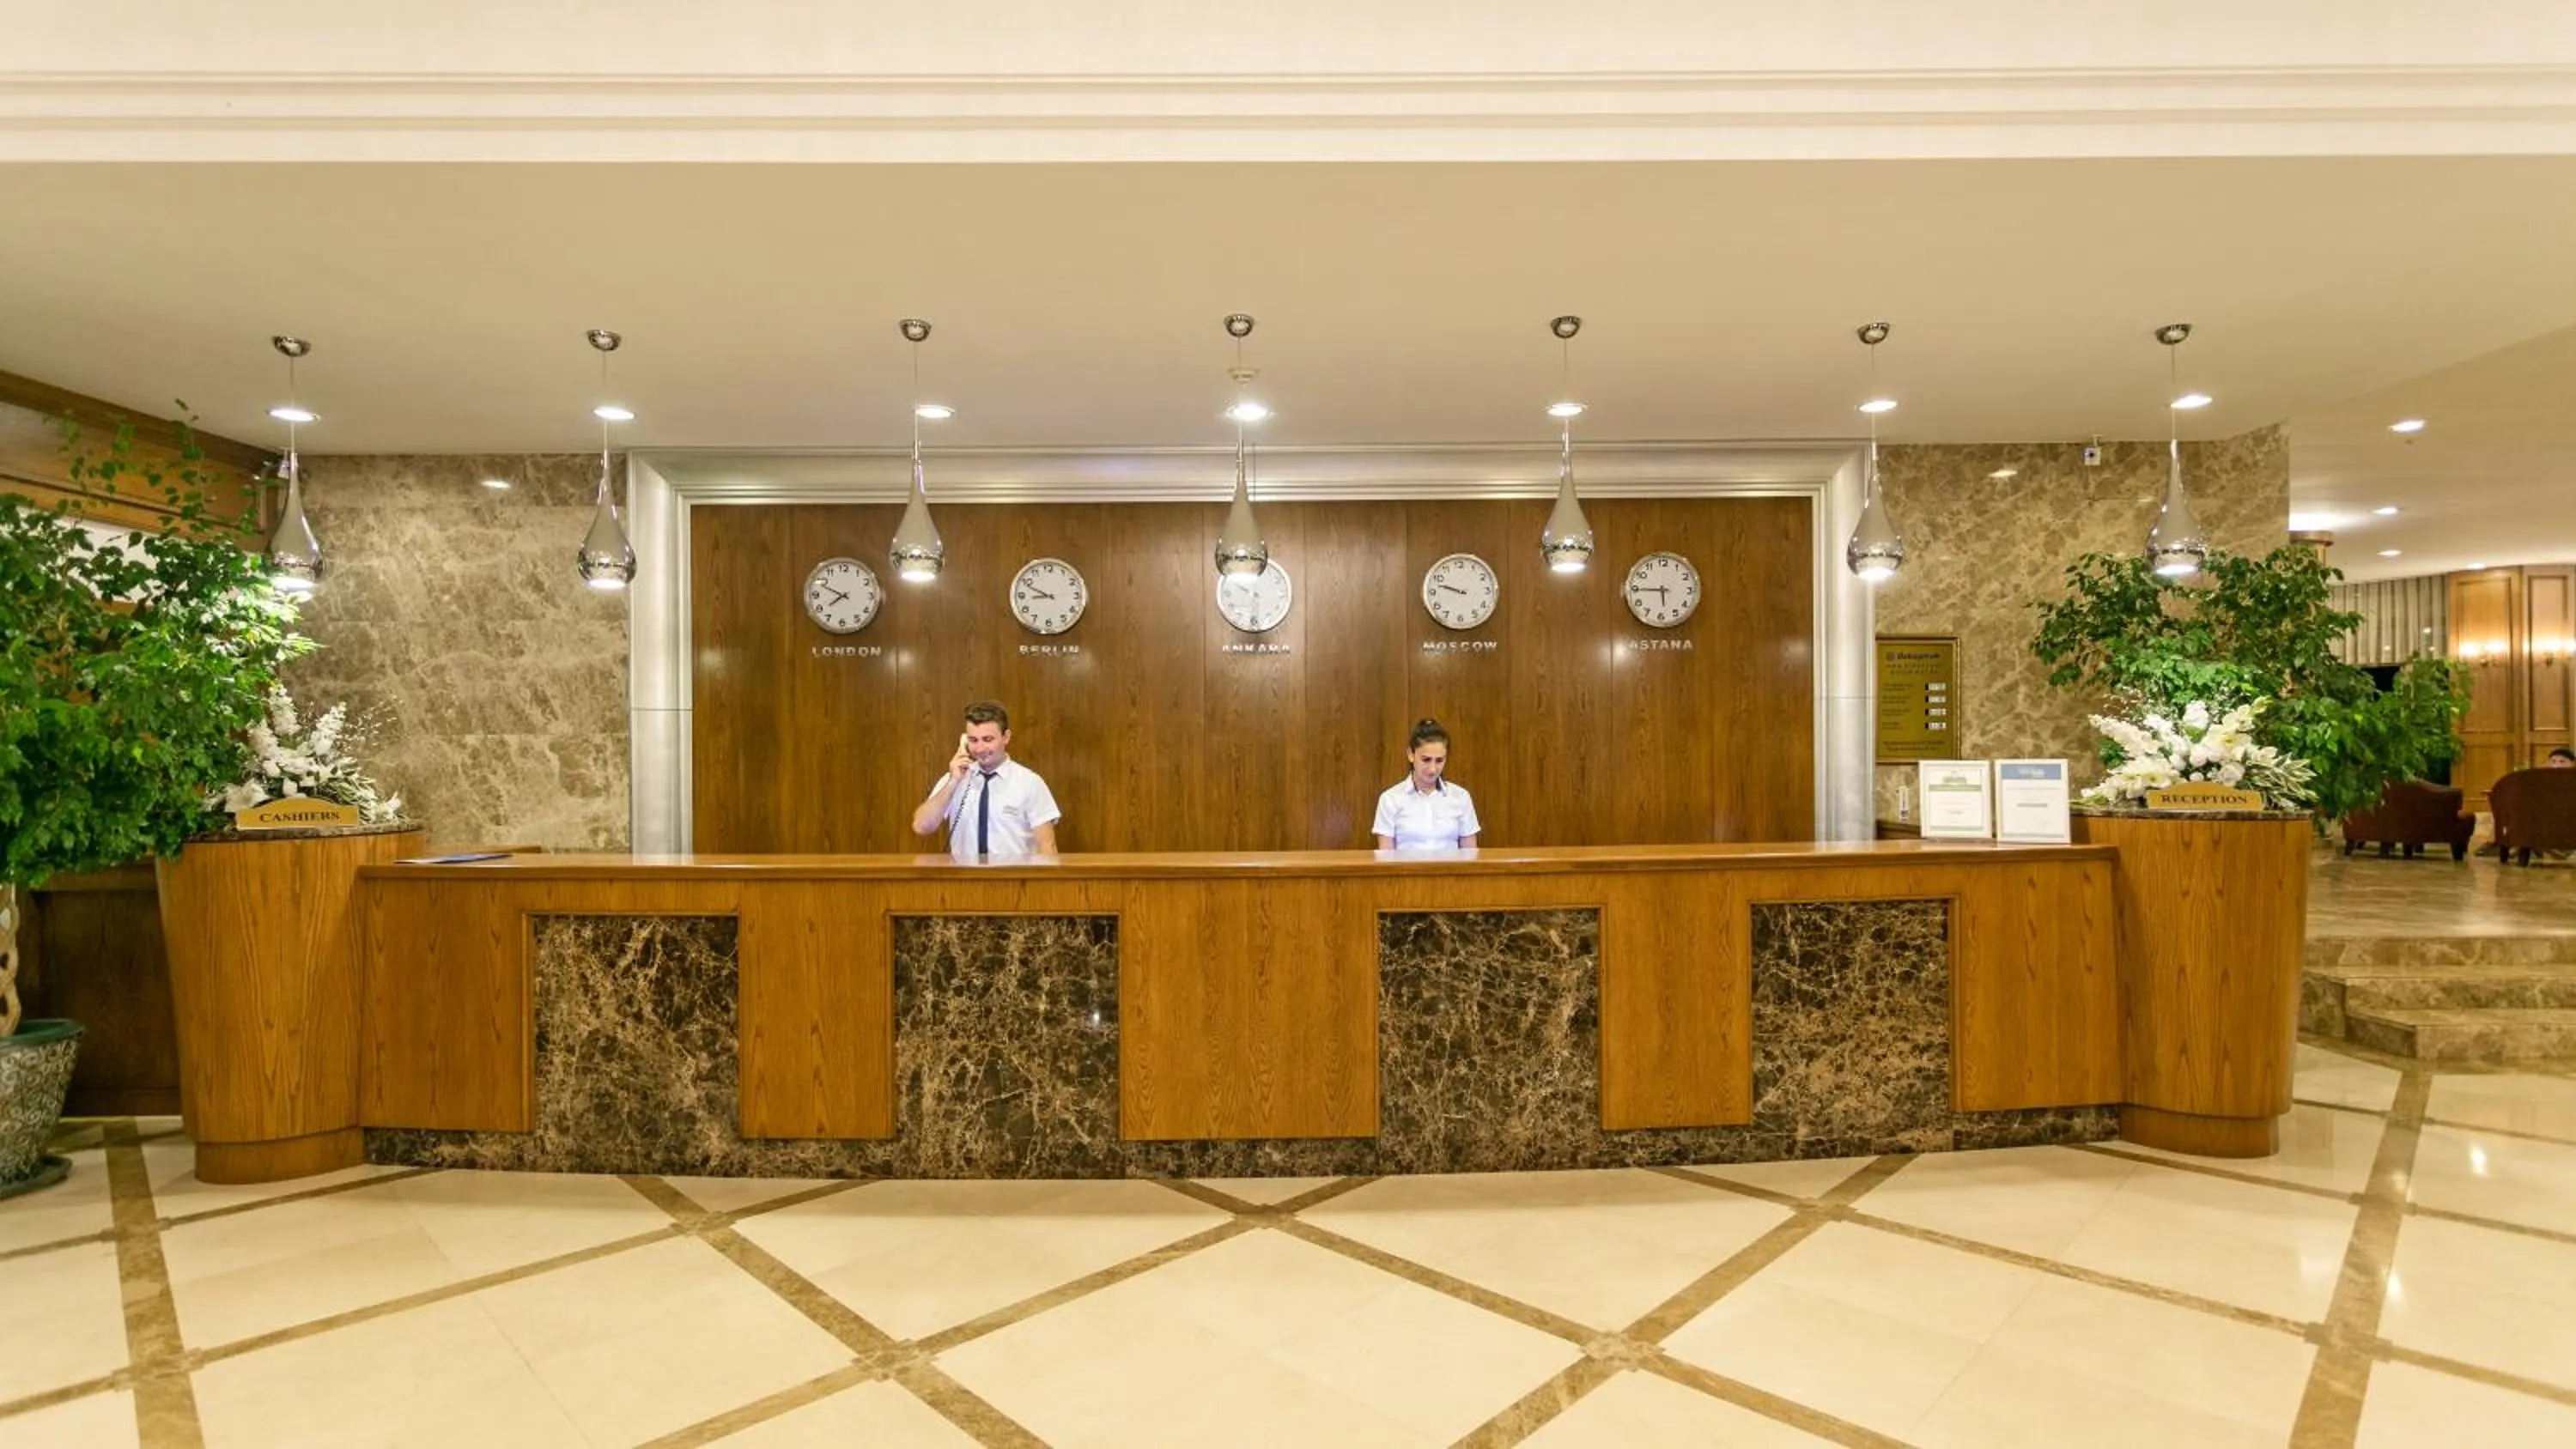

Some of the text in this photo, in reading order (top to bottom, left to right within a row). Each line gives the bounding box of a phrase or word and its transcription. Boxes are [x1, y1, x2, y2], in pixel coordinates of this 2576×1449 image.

[1019, 645, 1079, 656] BERLIN
[1423, 641, 1498, 652] MOSCOW
[1629, 640, 1693, 650] ASTANA
[811, 646, 881, 657] LONDON
[2160, 794, 2247, 804] RECEPTION
[258, 811, 341, 822] CASHIERS
